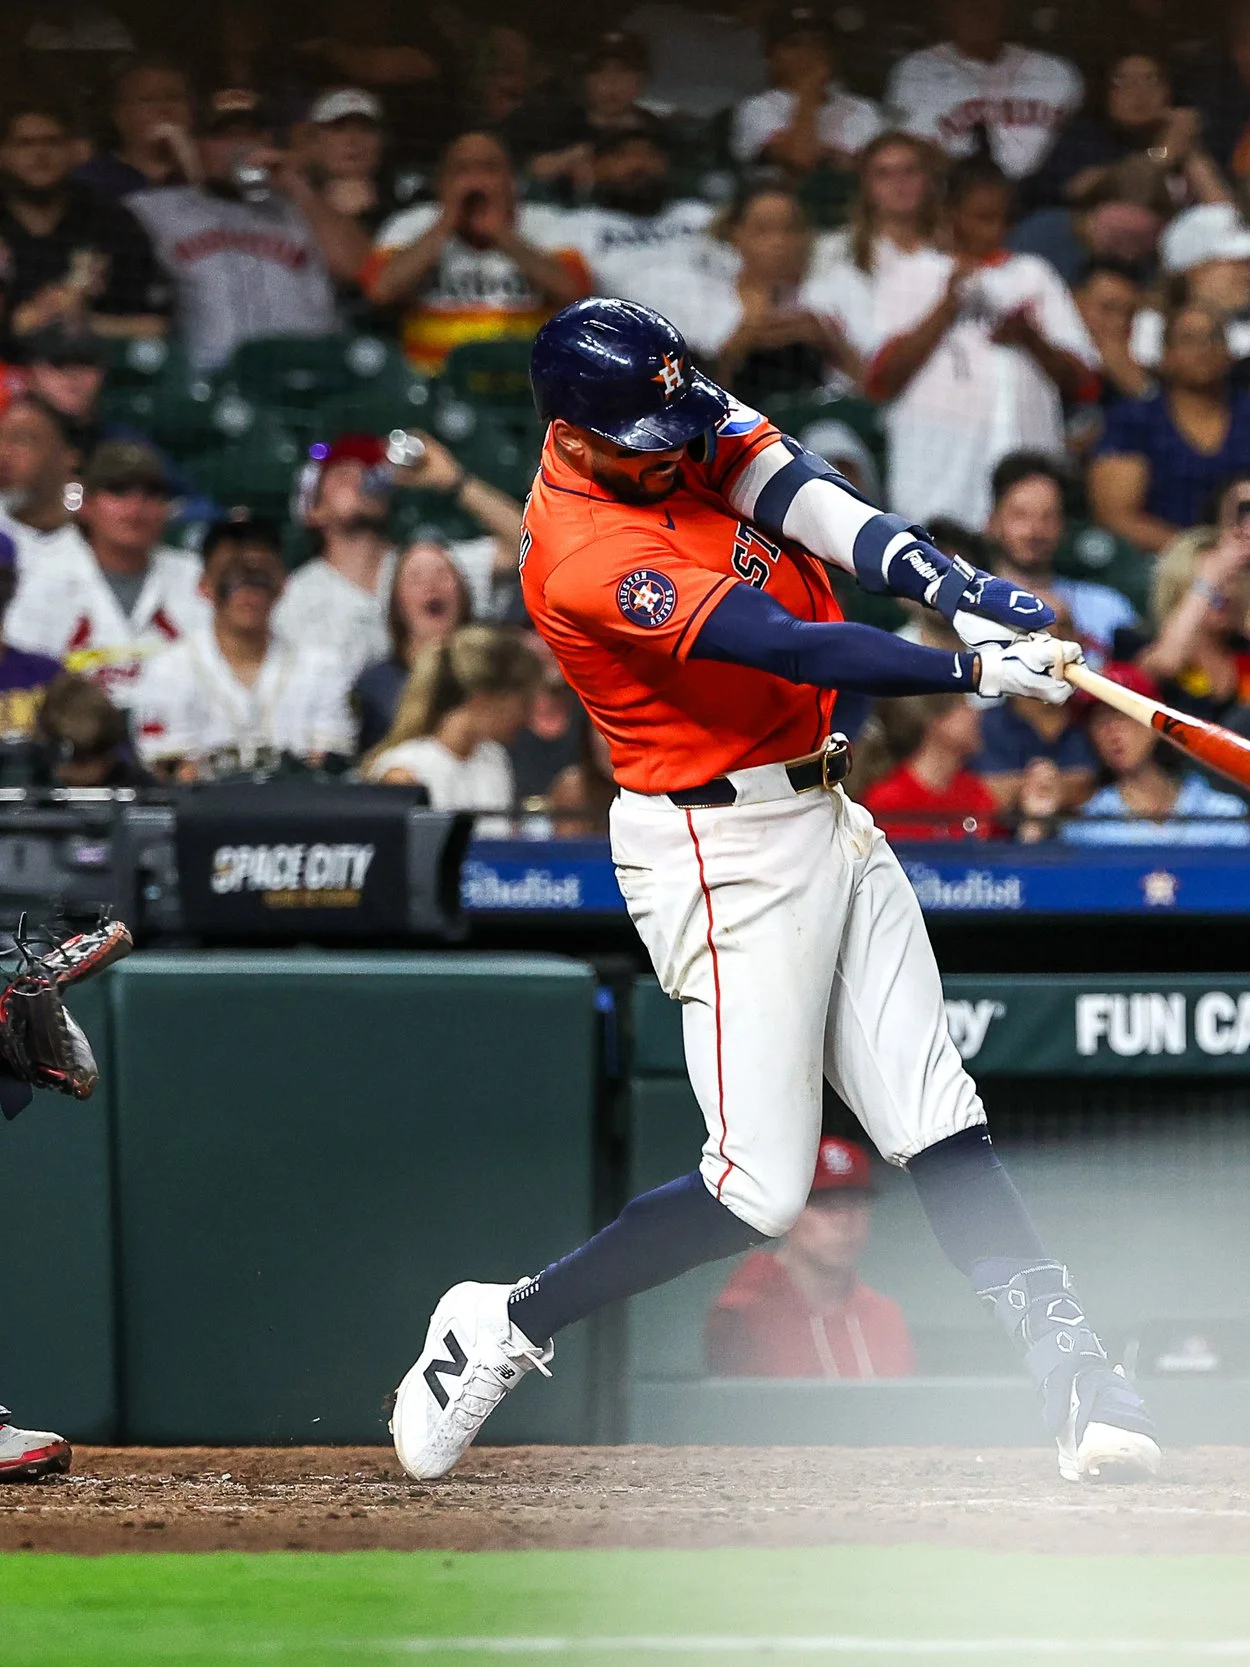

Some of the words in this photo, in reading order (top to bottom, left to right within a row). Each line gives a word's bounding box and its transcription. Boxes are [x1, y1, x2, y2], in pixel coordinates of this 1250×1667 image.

[658, 358, 684, 396] H
[620, 571, 648, 611] HOUSTON
[649, 589, 674, 625] ASTROS
[210, 843, 307, 894] SPACE
[304, 842, 376, 891] CITY
[1076, 992, 1188, 1056] FUN
[423, 1329, 469, 1412] N
